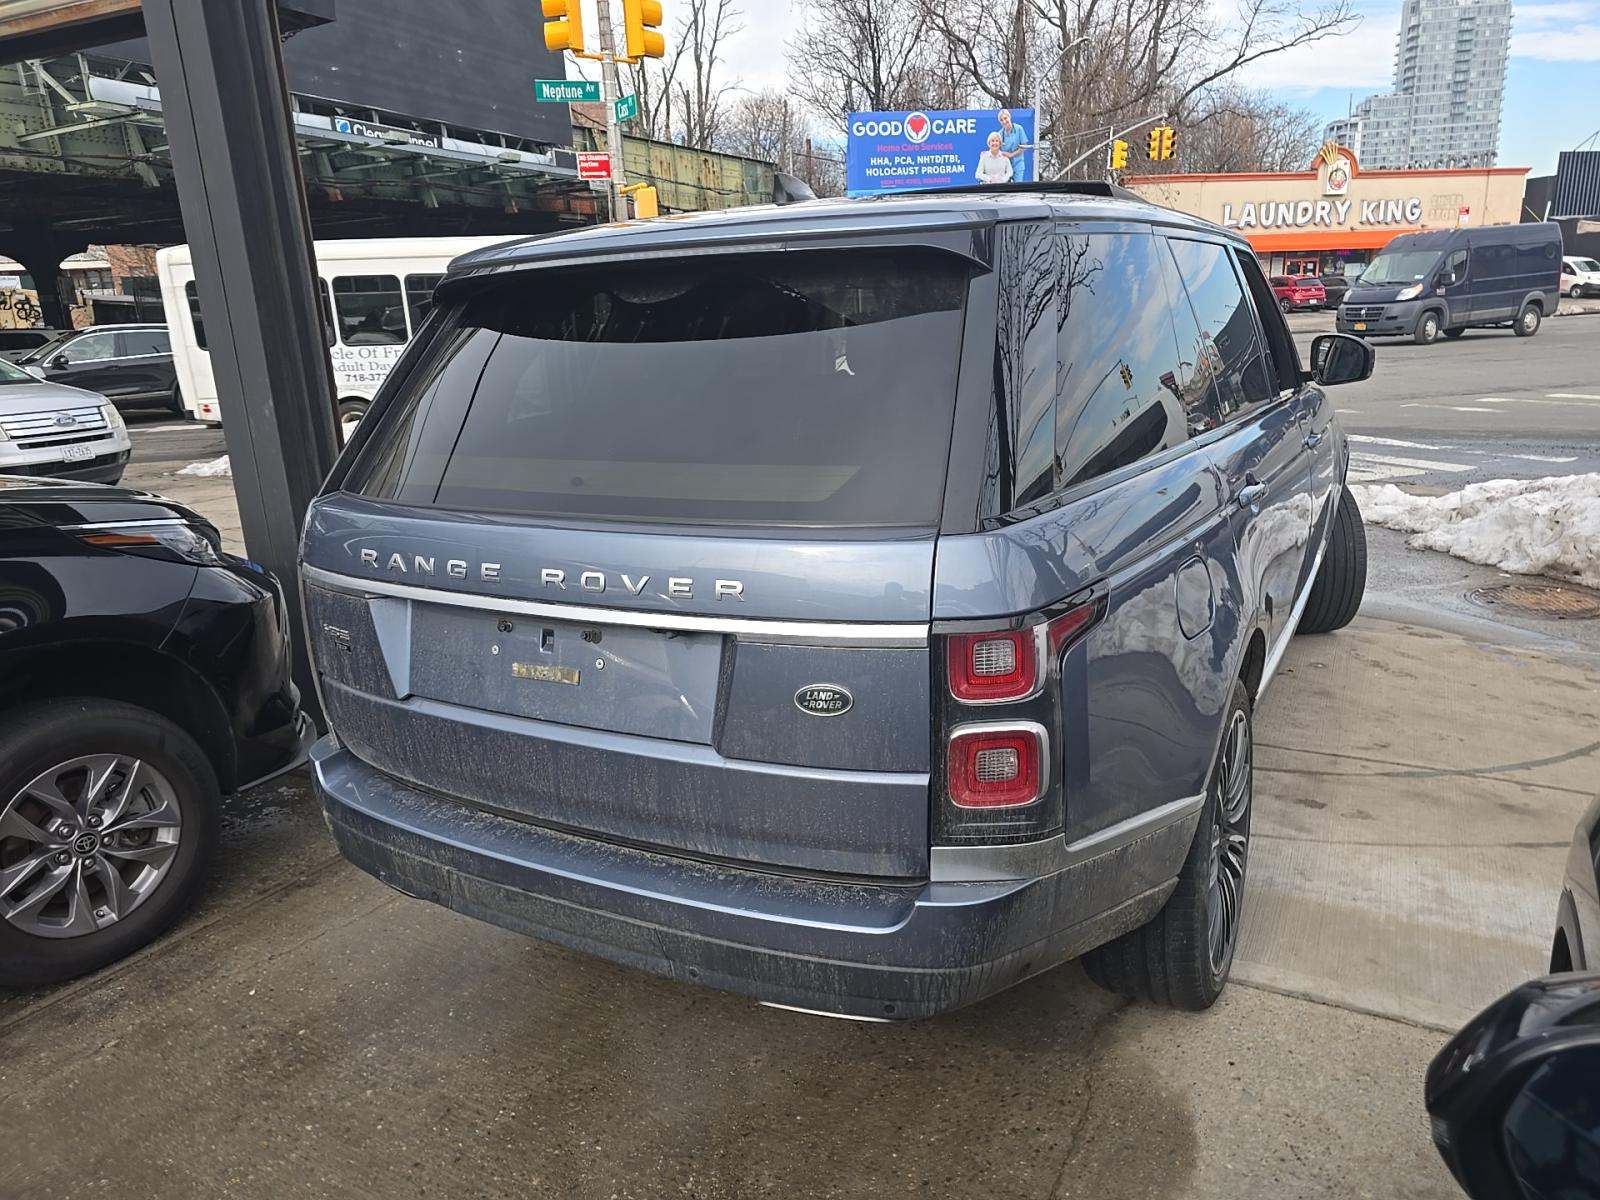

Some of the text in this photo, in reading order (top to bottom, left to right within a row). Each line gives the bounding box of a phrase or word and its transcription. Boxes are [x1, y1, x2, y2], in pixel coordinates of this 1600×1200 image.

[542, 83, 595, 100] Neptune Av
[853, 119, 976, 136] GOOD CARE
[877, 142, 953, 152] Home Care Services
[870, 157, 892, 166] HHA,
[895, 156, 914, 165] PCA,
[866, 165, 965, 177] HOLOCAUST PROGRAM
[1223, 201, 1352, 228] LAUNDRY
[1361, 198, 1422, 225] KING
[358, 347, 376, 358] Of
[383, 347, 404, 358] Fr
[335, 361, 366, 372] dult
[361, 548, 744, 602] RANGE ROVER
[806, 691, 834, 700] LAND
[809, 700, 842, 709] ROVER
